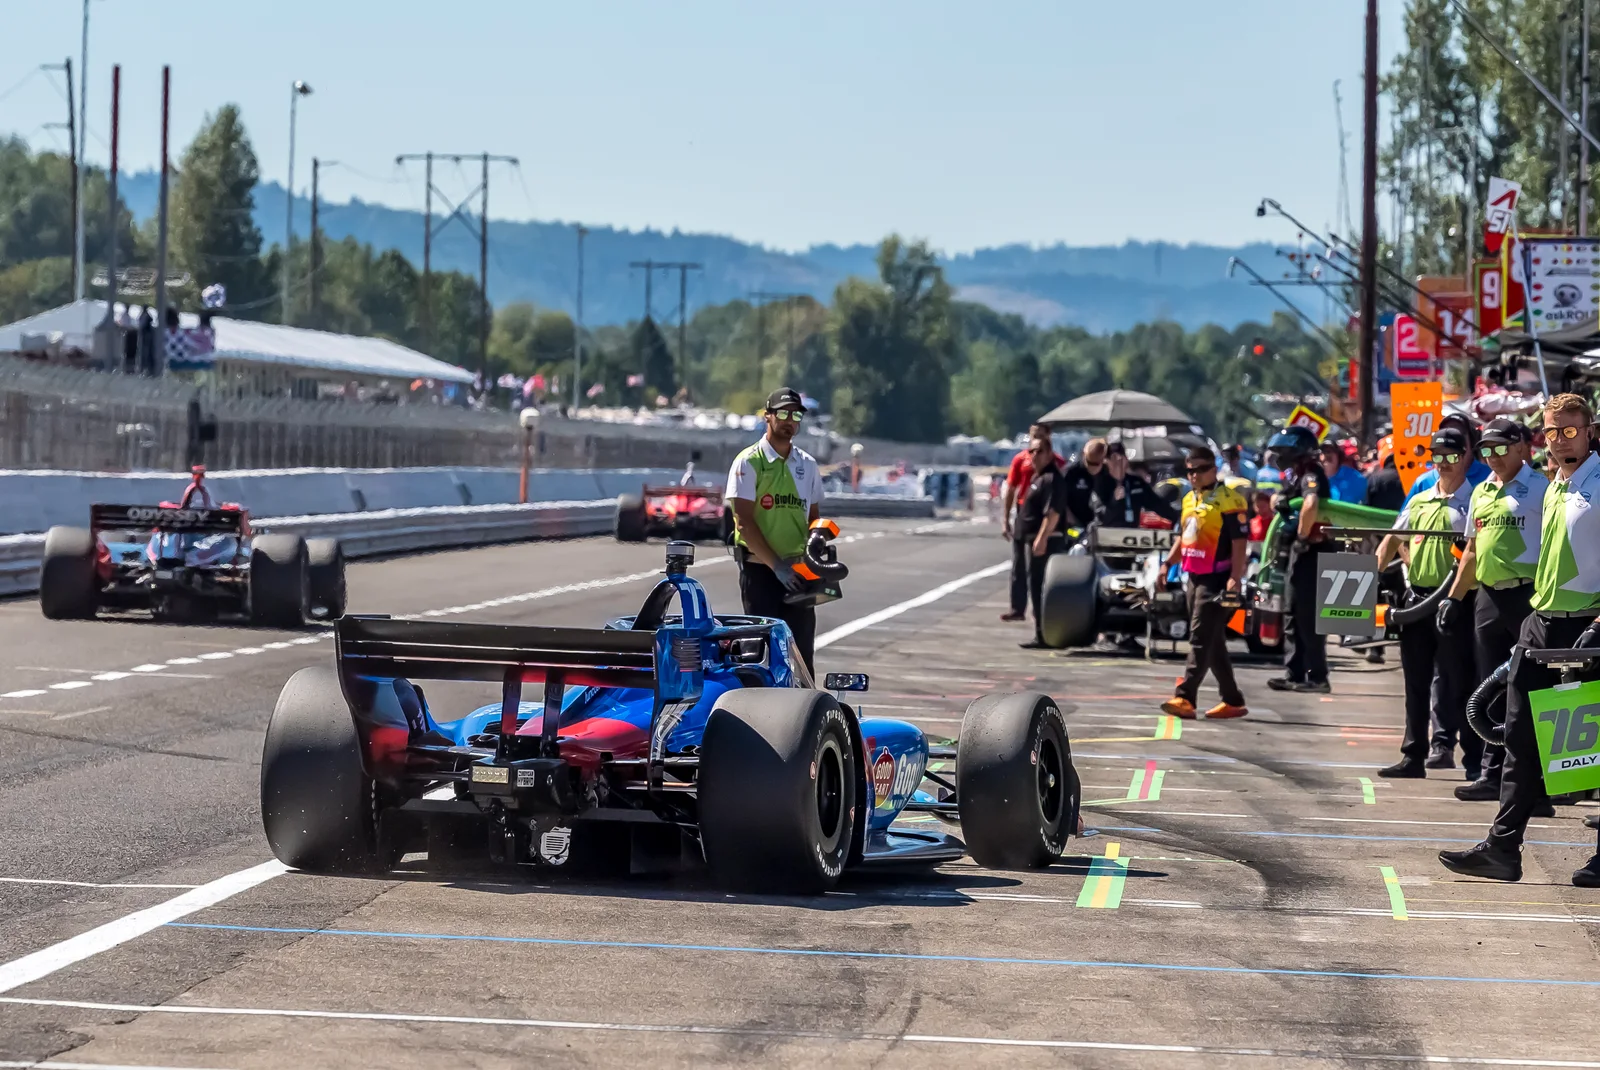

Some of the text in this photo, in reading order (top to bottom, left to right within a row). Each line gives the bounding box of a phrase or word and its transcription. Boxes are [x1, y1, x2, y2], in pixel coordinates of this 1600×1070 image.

[1482, 270, 1500, 309] 9
[1400, 322, 1420, 354] 2
[1438, 307, 1475, 347] 14
[1404, 412, 1434, 438] 30
[126, 507, 210, 521] ODYSSEY
[1321, 569, 1374, 606] 77
[1329, 609, 1363, 618] ROBB
[1538, 702, 1600, 756] 76
[875, 761, 892, 780] GOOD
[1561, 755, 1598, 769] DALY
[874, 783, 890, 796] EART
